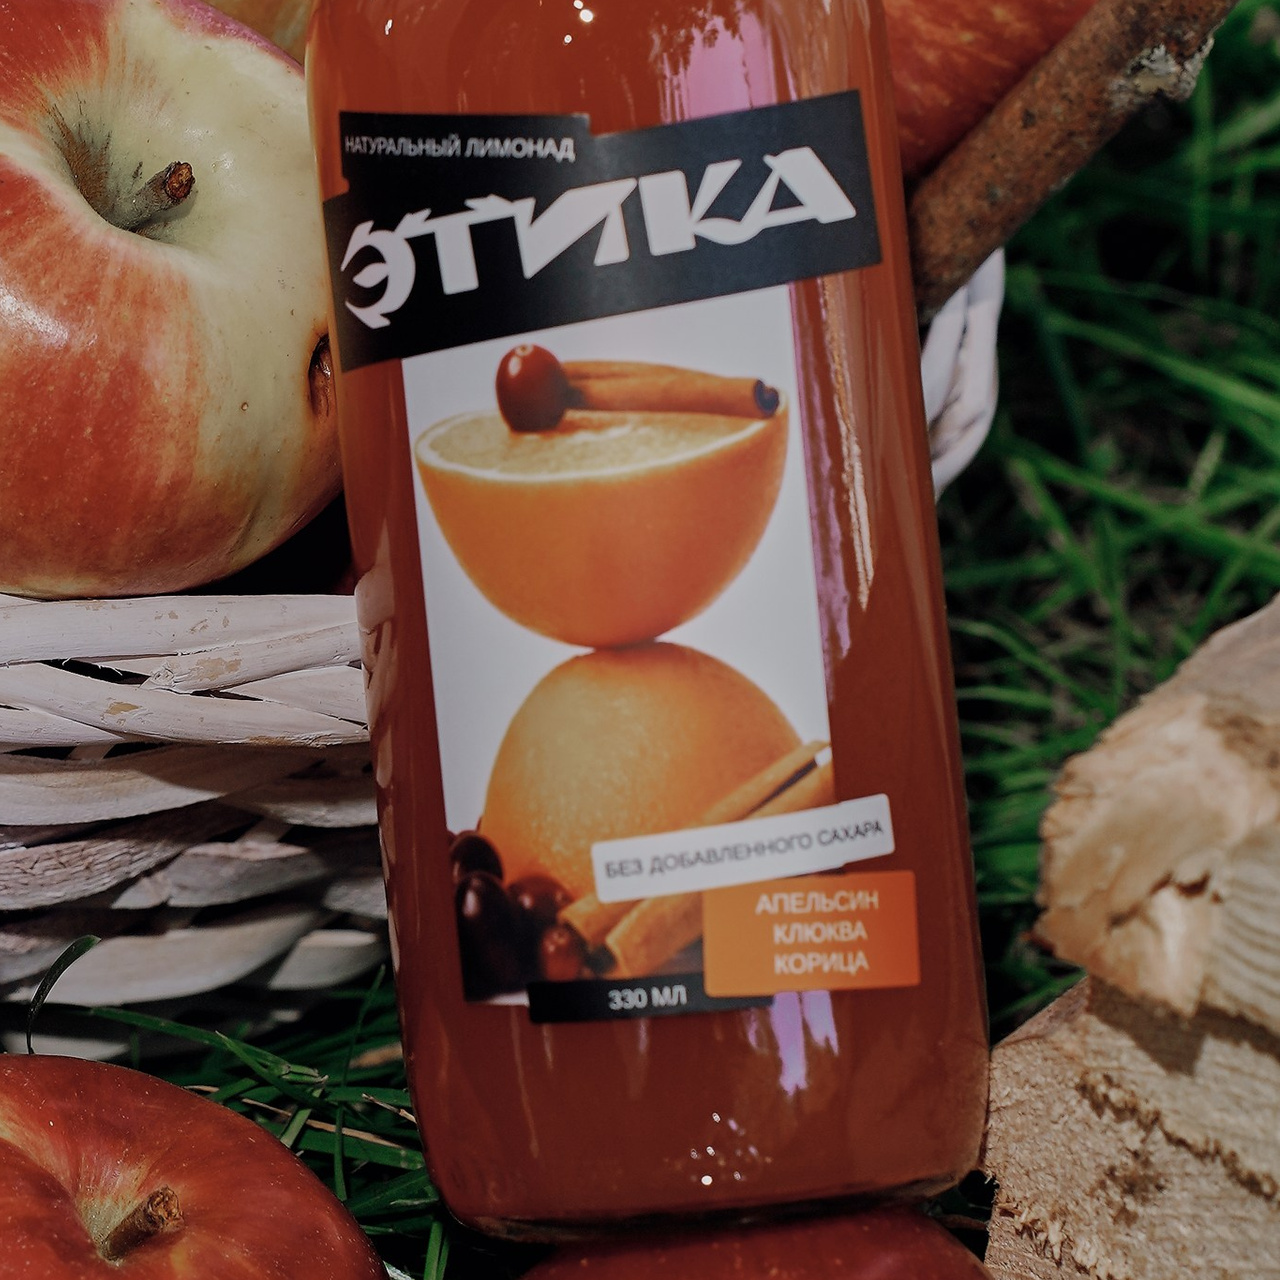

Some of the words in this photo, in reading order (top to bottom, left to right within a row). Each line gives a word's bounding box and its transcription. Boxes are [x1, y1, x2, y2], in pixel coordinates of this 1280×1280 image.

[344, 133, 461, 159] НАТУРАЛЬНЫЙ
[465, 137, 576, 163] ЛИМОНАД
[340, 146, 857, 329] ЭТИКА
[604, 857, 644, 879] БЕЗ
[648, 833, 813, 876] ДОБАВЛЕННОГО
[818, 819, 884, 848] САХАРА
[755, 889, 880, 916] АПЕЛЬСИН
[772, 922, 868, 946] КЛЮКВА
[773, 950, 869, 976] КОРИЦА
[607, 987, 647, 1011] 330
[650, 984, 688, 1008] МЛ
